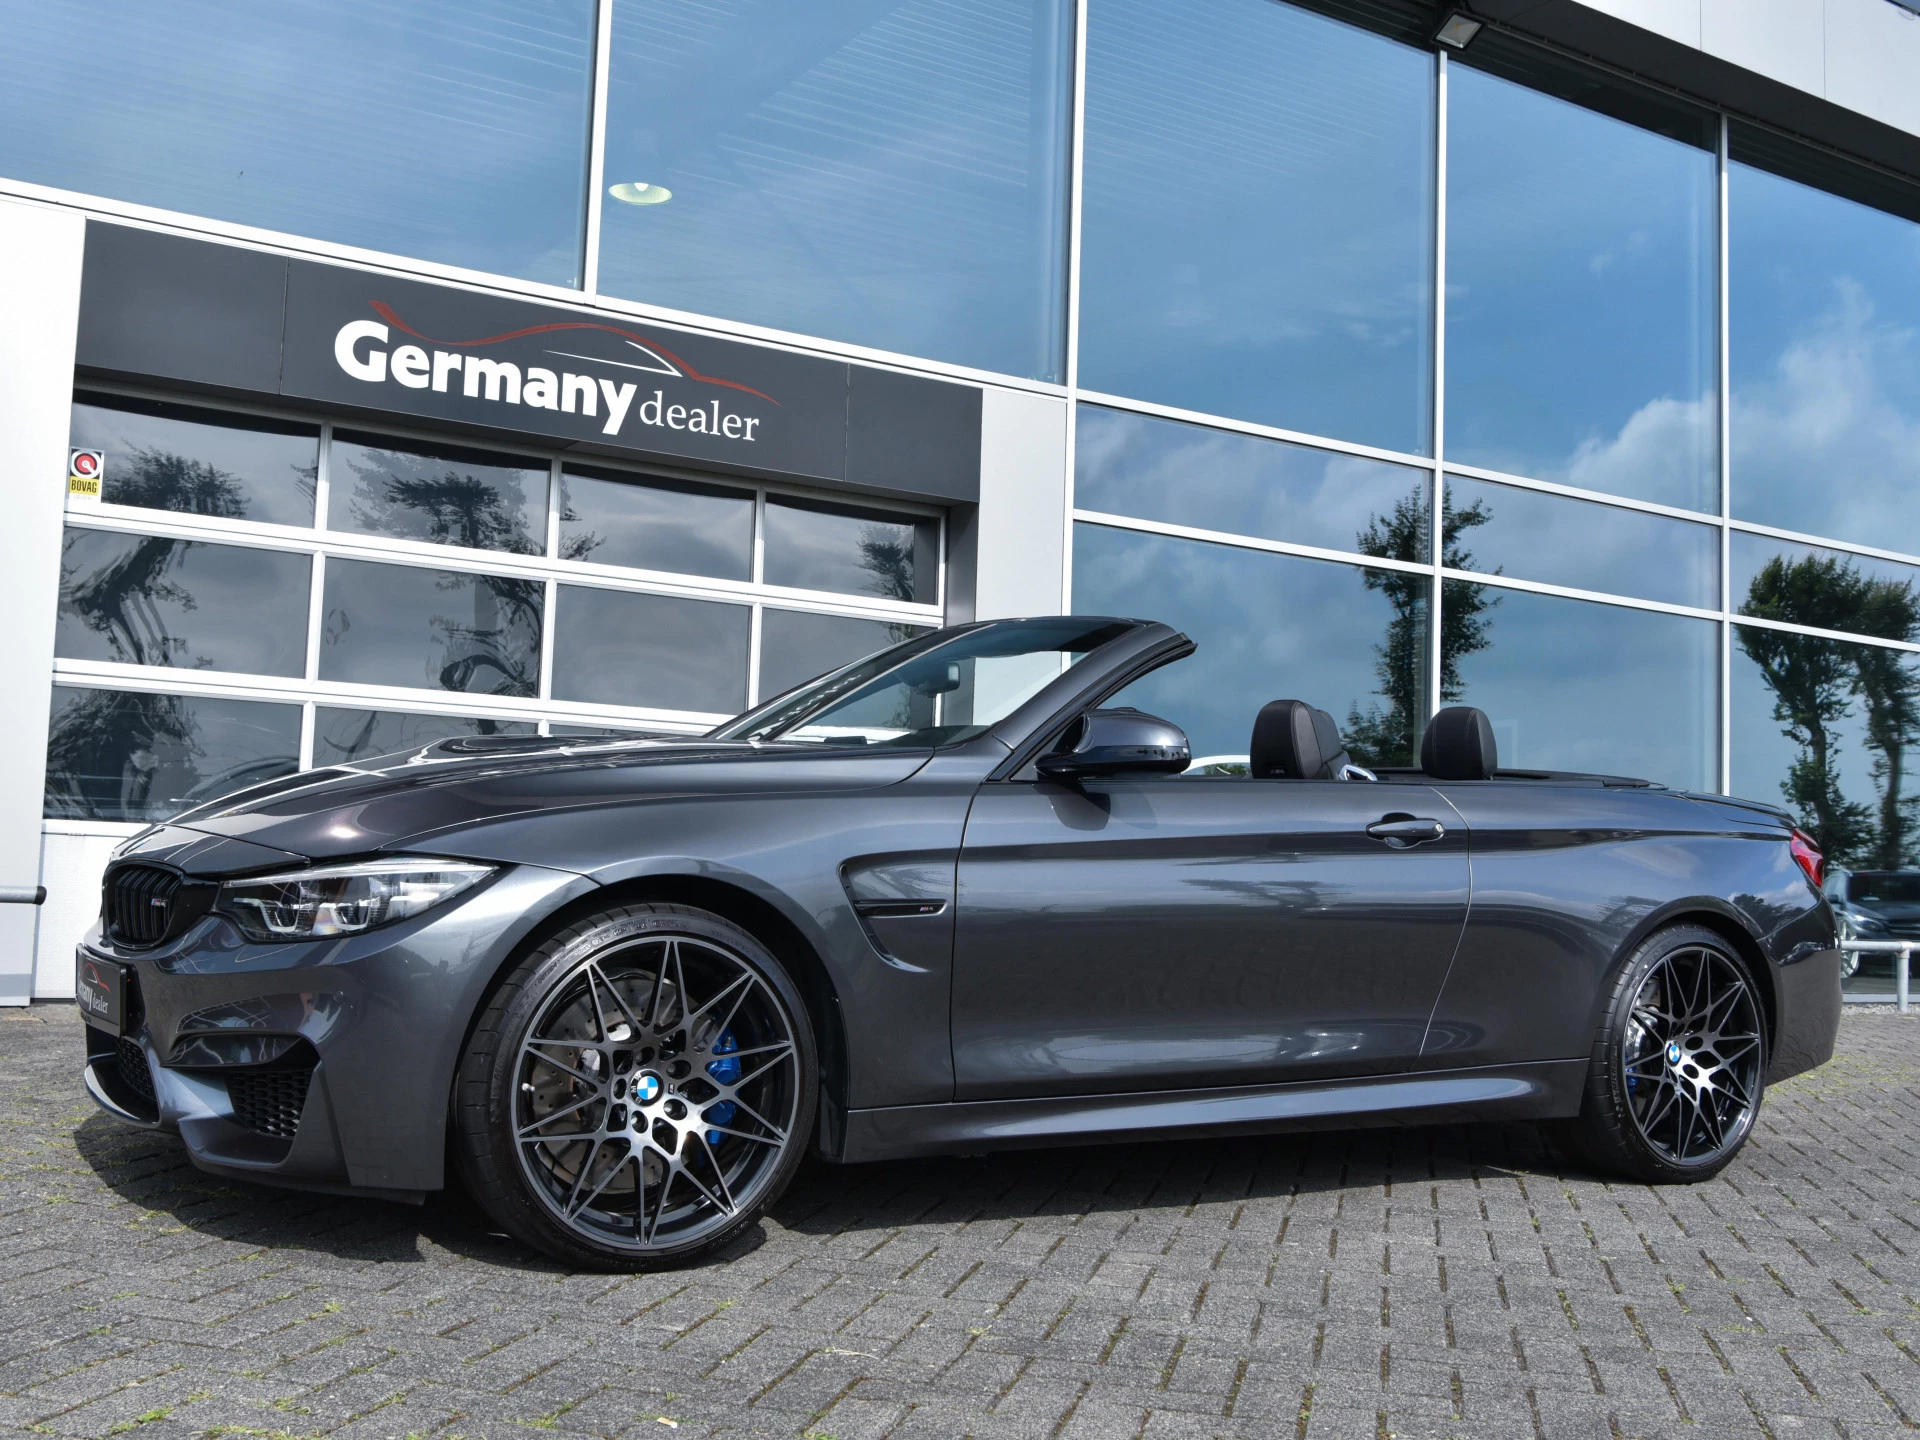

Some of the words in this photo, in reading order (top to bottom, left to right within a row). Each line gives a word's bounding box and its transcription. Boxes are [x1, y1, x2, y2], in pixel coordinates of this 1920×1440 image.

[334, 319, 638, 436] Germany
[639, 390, 760, 442] dealer
[71, 479, 97, 494] BOVAG
